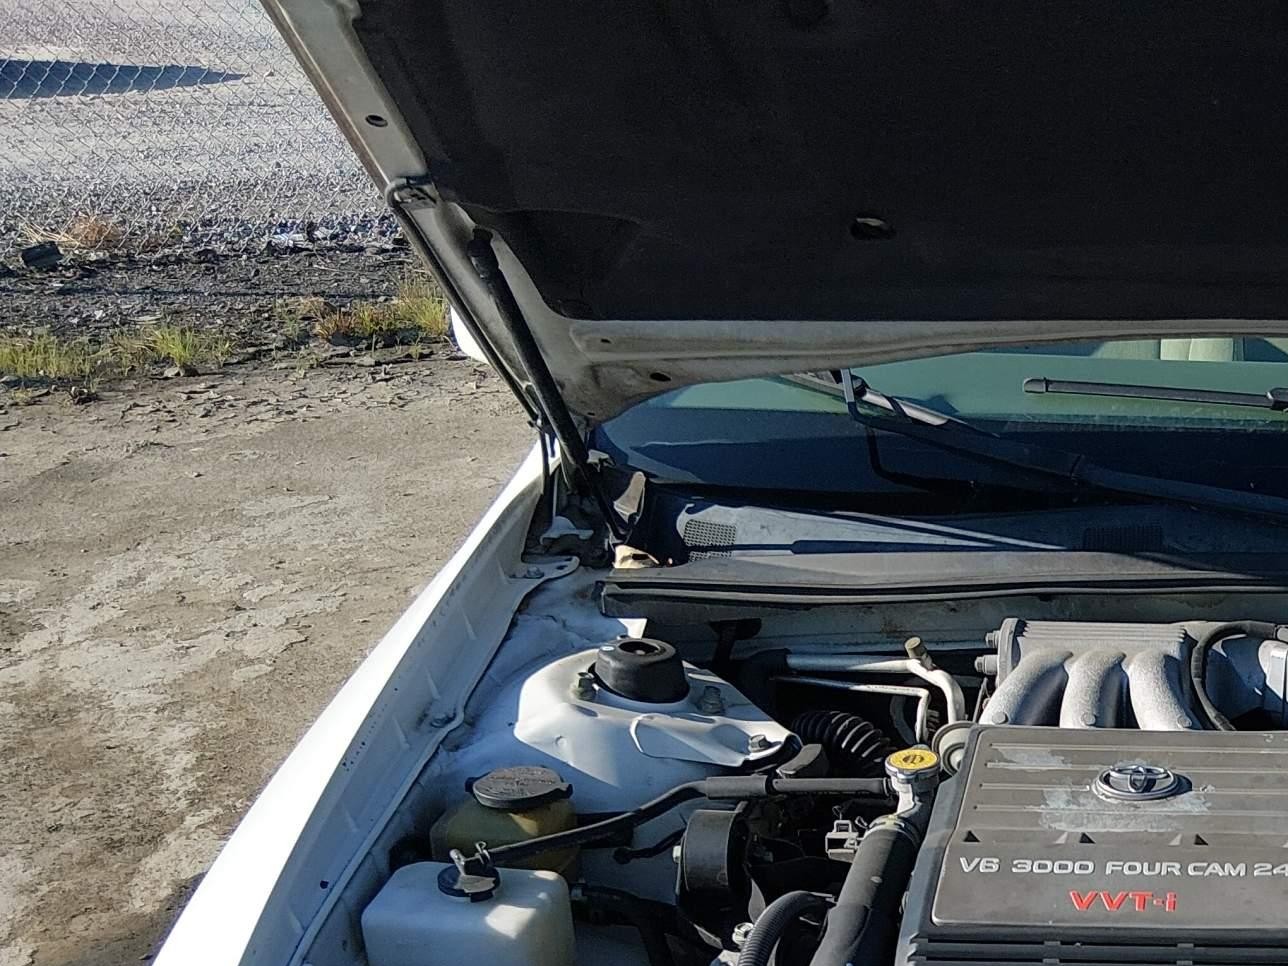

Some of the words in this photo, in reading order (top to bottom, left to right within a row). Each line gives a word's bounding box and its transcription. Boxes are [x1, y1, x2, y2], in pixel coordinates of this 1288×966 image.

[959, 857, 1000, 873] V6
[1011, 859, 1095, 875] 3000
[1105, 861, 1181, 876] FOUR
[1187, 862, 1247, 877] CAM
[1069, 890, 1177, 912] VVT-i
